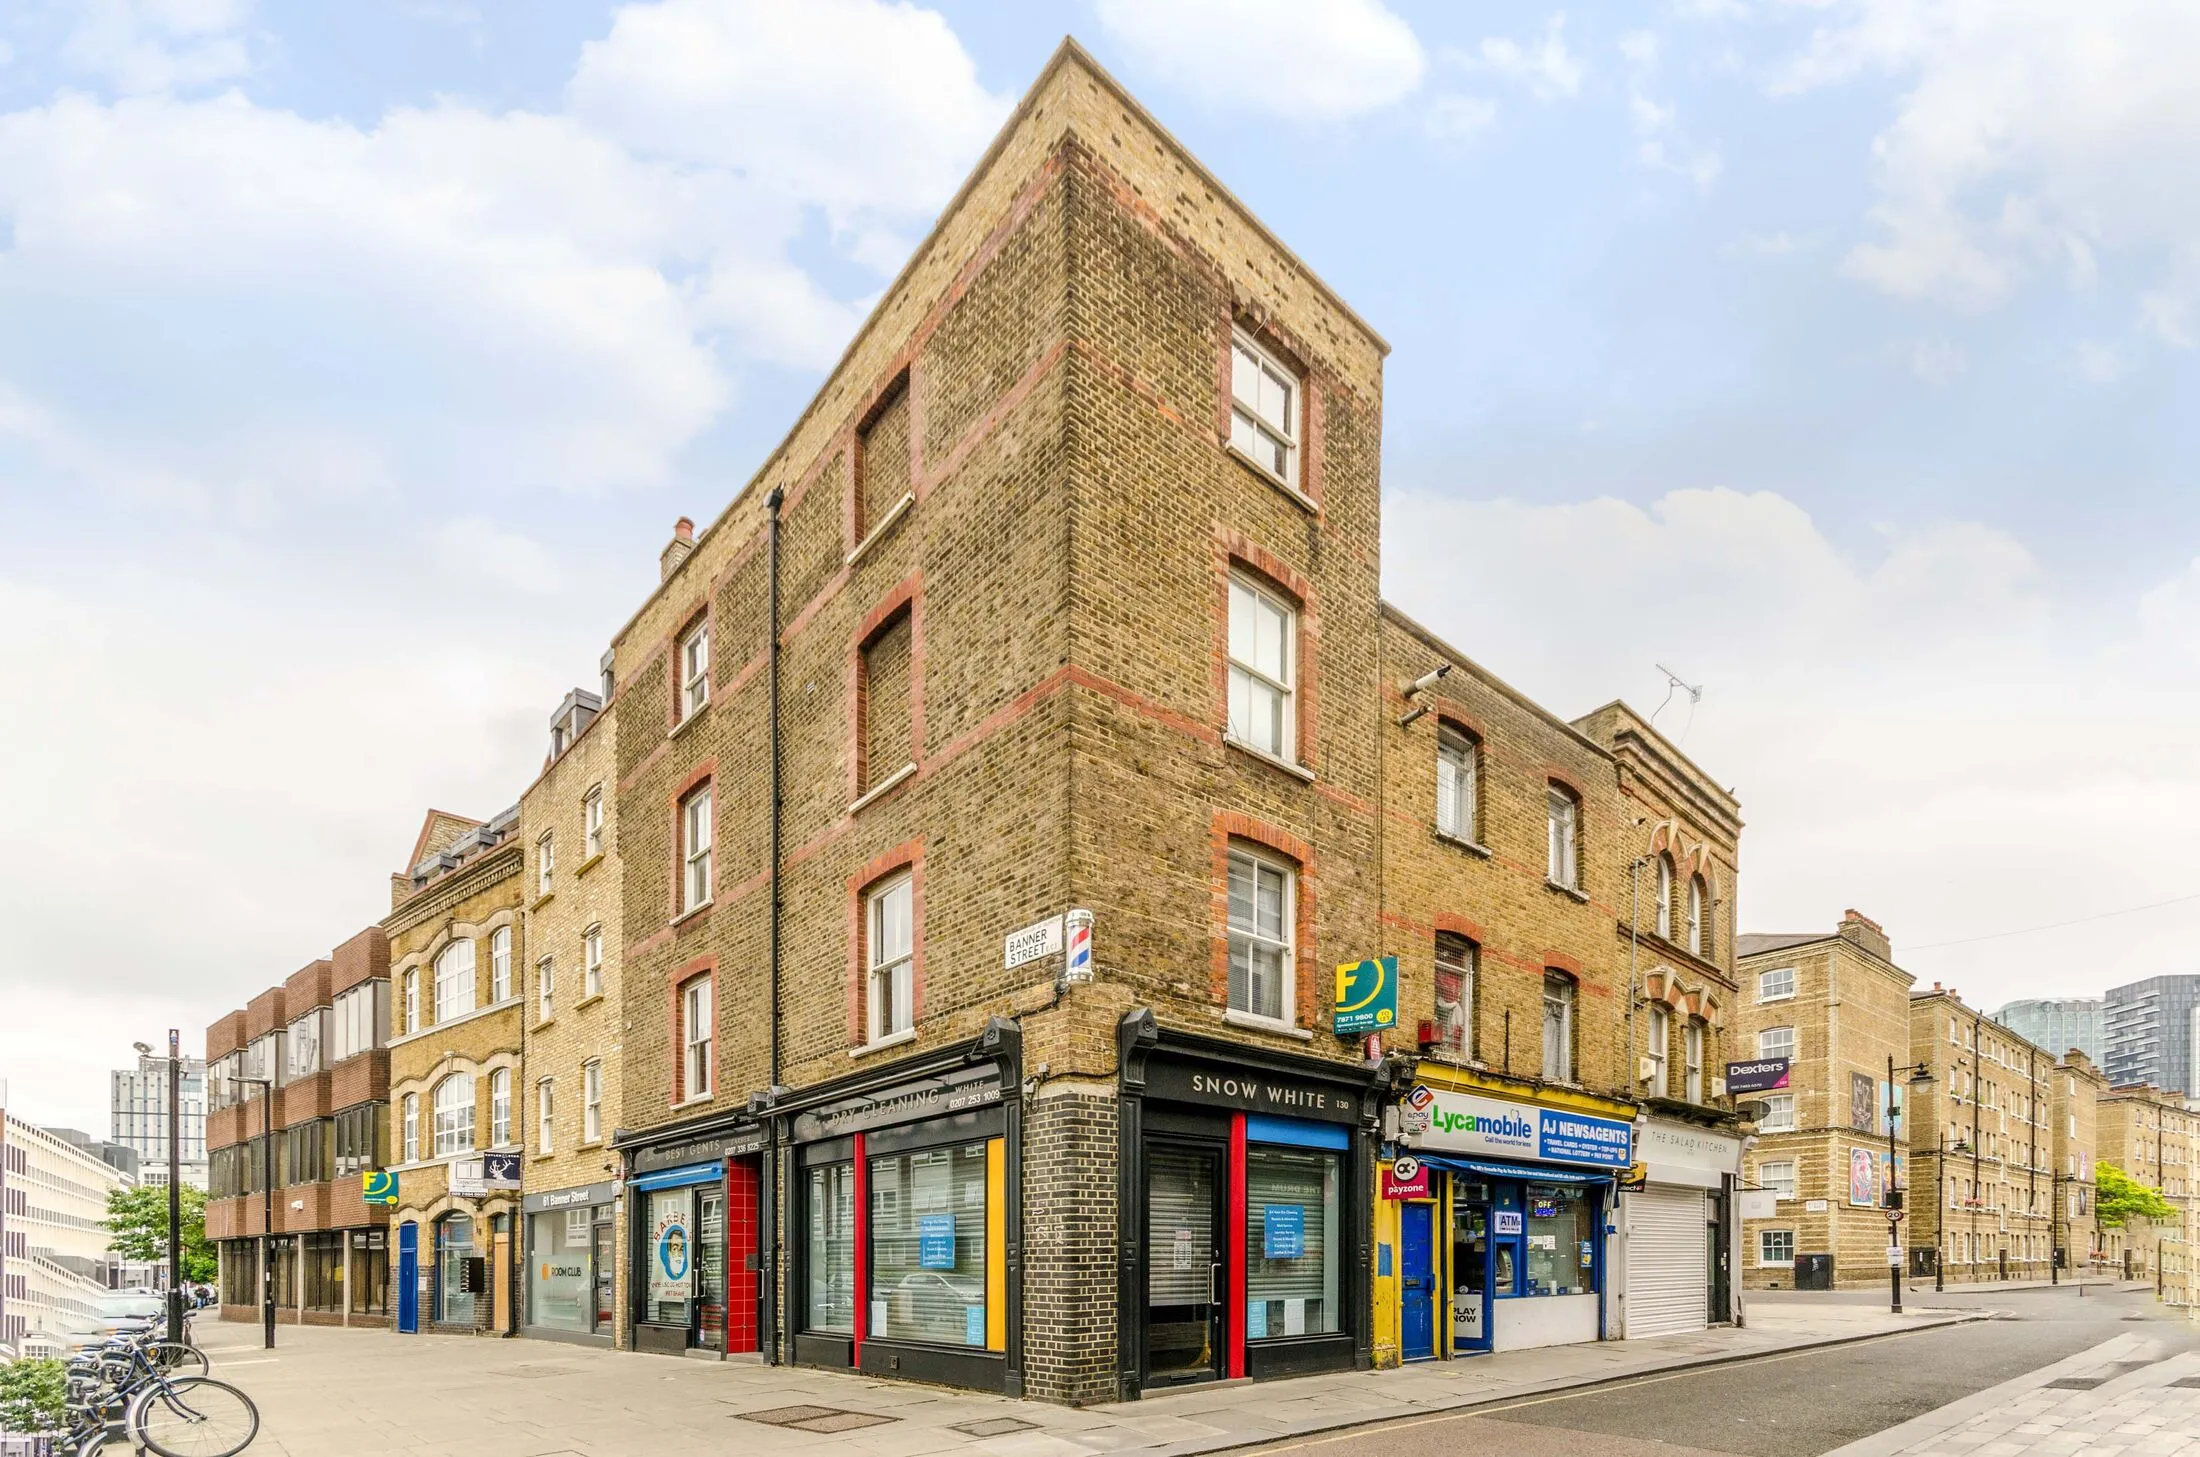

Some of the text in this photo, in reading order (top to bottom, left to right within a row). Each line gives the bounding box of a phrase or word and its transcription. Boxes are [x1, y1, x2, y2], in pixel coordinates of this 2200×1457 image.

[1009, 928, 1047, 953] BANNER
[1010, 942, 1046, 965] STREET
[1336, 1013, 1374, 1023] 7871 9800
[1730, 1063, 1784, 1076] Dexters
[955, 1080, 985, 1095] WHITE
[1192, 1075, 1349, 1110] SNOW WHITE 130
[950, 1089, 1000, 1109] 0207 253 1009
[831, 1088, 940, 1127] DRY CLEANING
[1407, 1111, 1429, 1120] epay
[1432, 1104, 1532, 1139] Lycamobile
[1542, 1118, 1628, 1145] AJ NEWSAGENTS
[1547, 1139, 1563, 1147] TRAVEL
[1652, 1131, 1728, 1153] THE SALAD KITCHEN
[665, 1148, 686, 1161] BEST
[689, 1140, 720, 1156] GENTS
[1551, 1147, 1571, 1156] NATIONAL
[1572, 1149, 1591, 1158] LOTTERY
[1388, 1184, 1424, 1195] payzone
[542, 1189, 590, 1207] 61 Banner Street
[1500, 1215, 1517, 1226] ATM
[552, 1267, 582, 1277] ROOM CLUB
[1453, 1315, 1476, 1323] NOW
